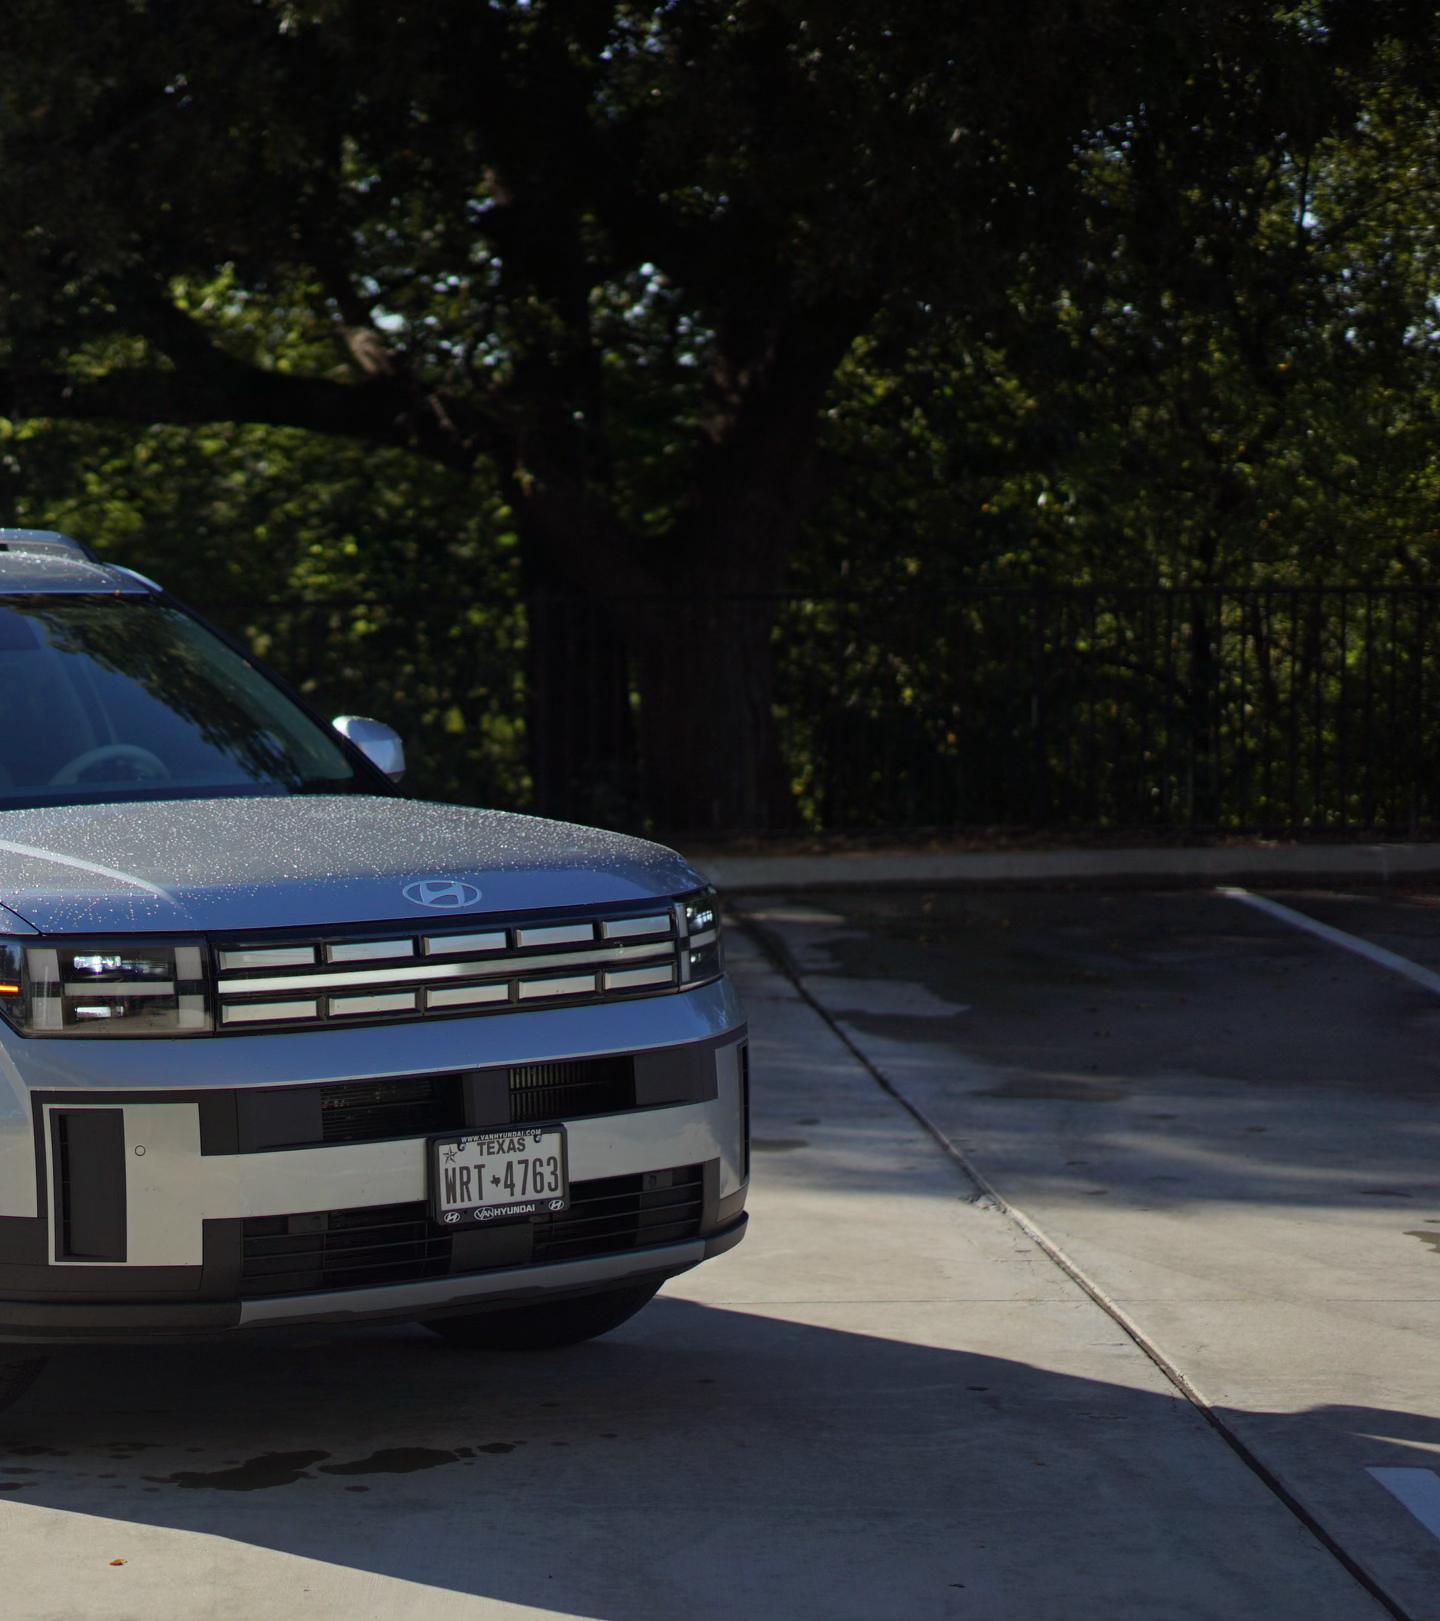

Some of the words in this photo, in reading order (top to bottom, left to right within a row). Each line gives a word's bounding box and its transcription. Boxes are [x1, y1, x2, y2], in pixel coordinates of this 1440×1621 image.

[461, 1128, 542, 1143] WWW.VANHYUNDAI.COM
[476, 1137, 526, 1157] TEXAS
[444, 1163, 486, 1205] WRT
[503, 1156, 559, 1197] 4763
[494, 1203, 536, 1216] HYUNDAI
